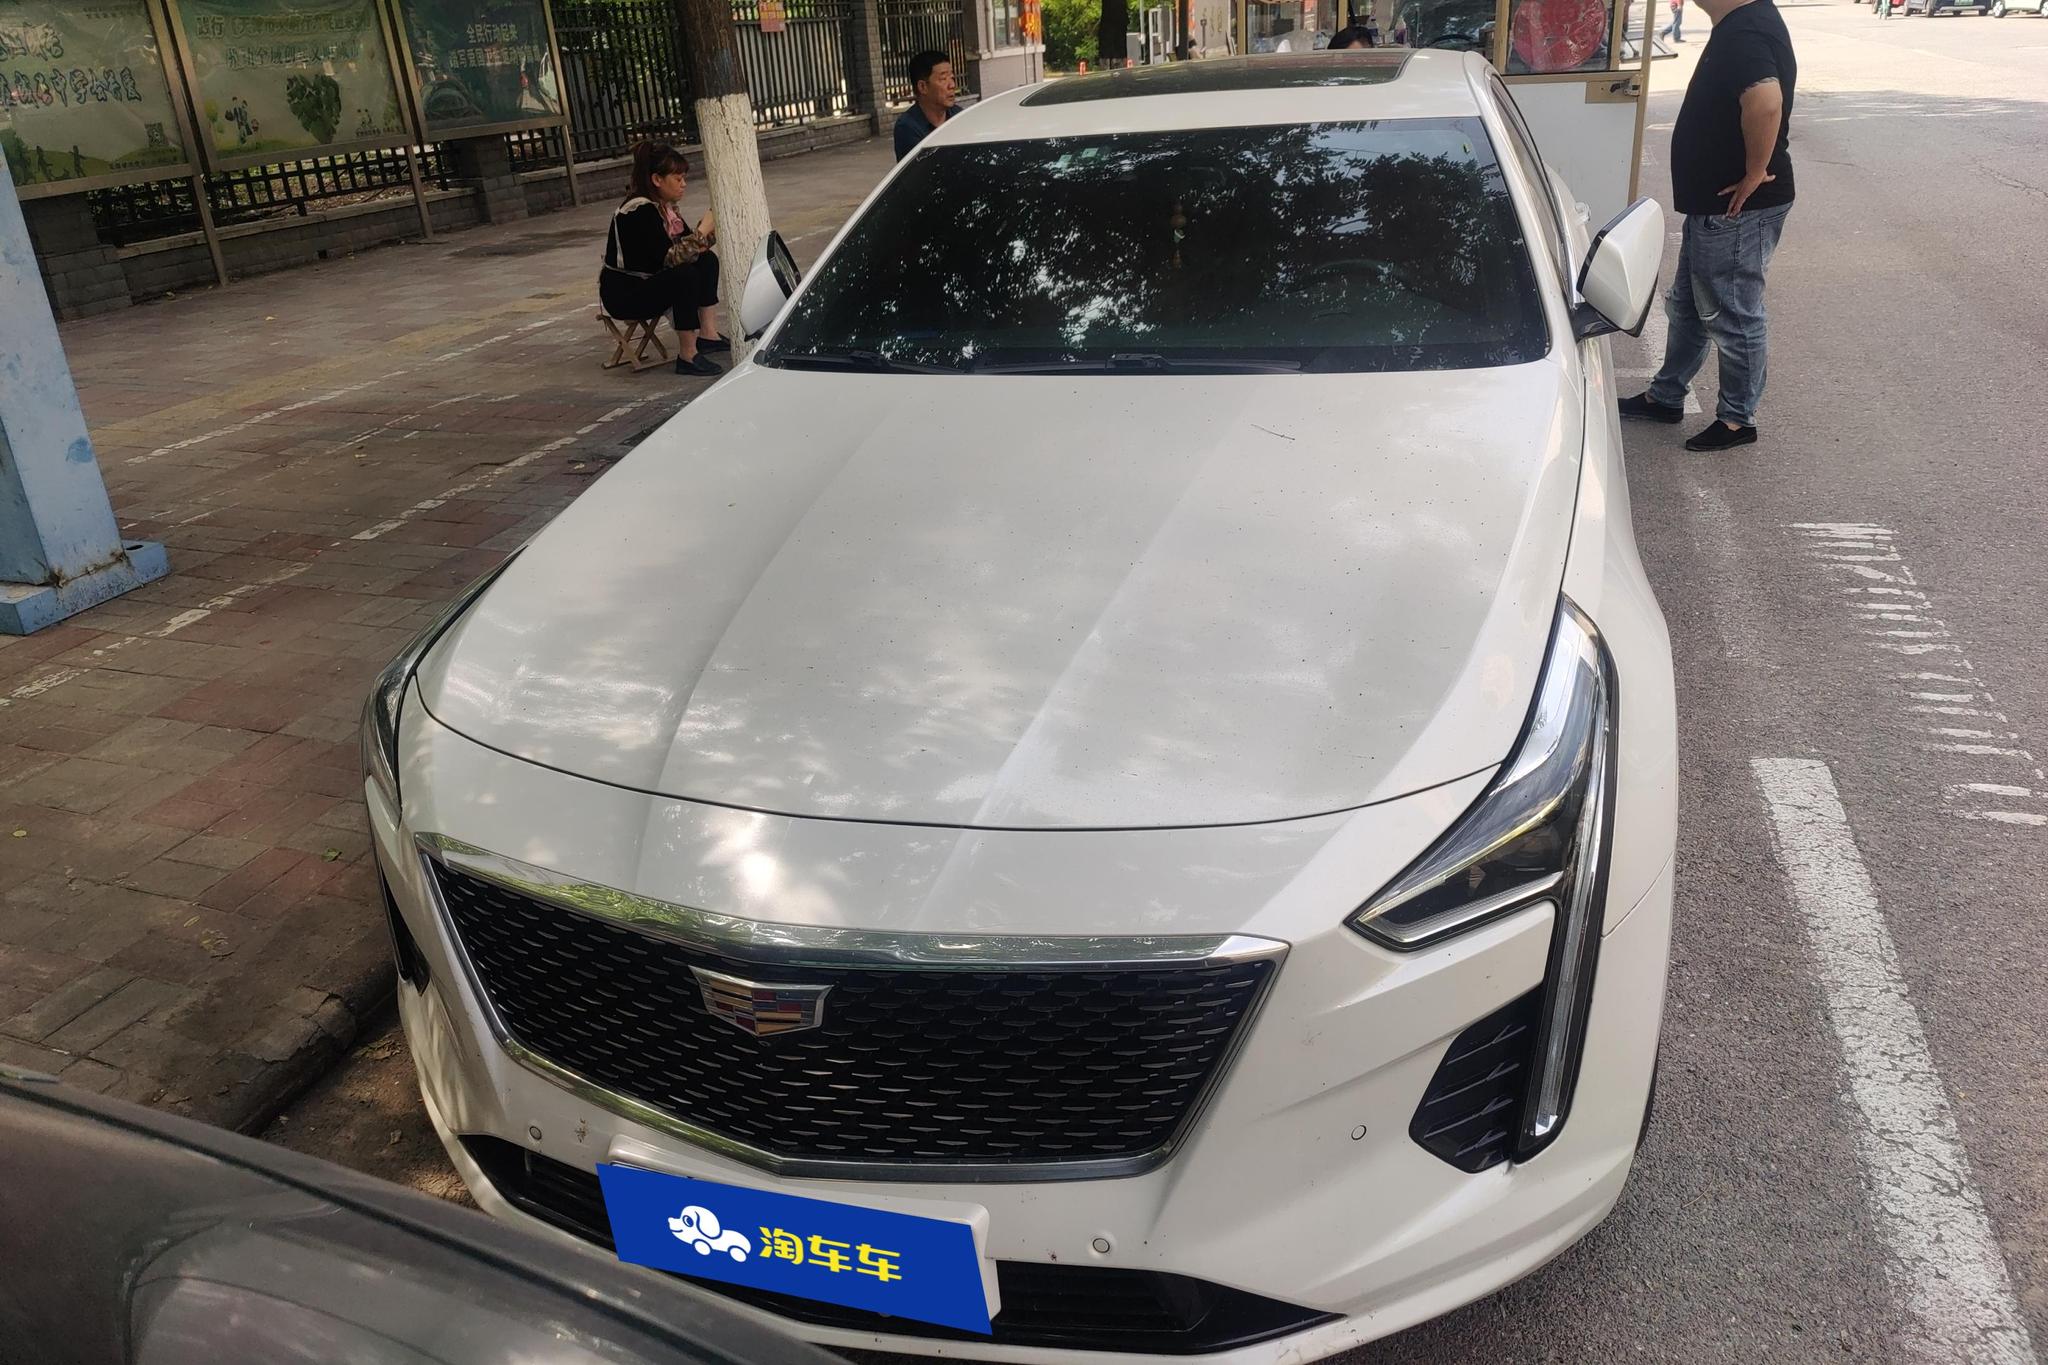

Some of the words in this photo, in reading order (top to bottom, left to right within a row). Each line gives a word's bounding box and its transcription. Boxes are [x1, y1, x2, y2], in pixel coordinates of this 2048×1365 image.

[466, 23, 518, 44] 全民行动起来
